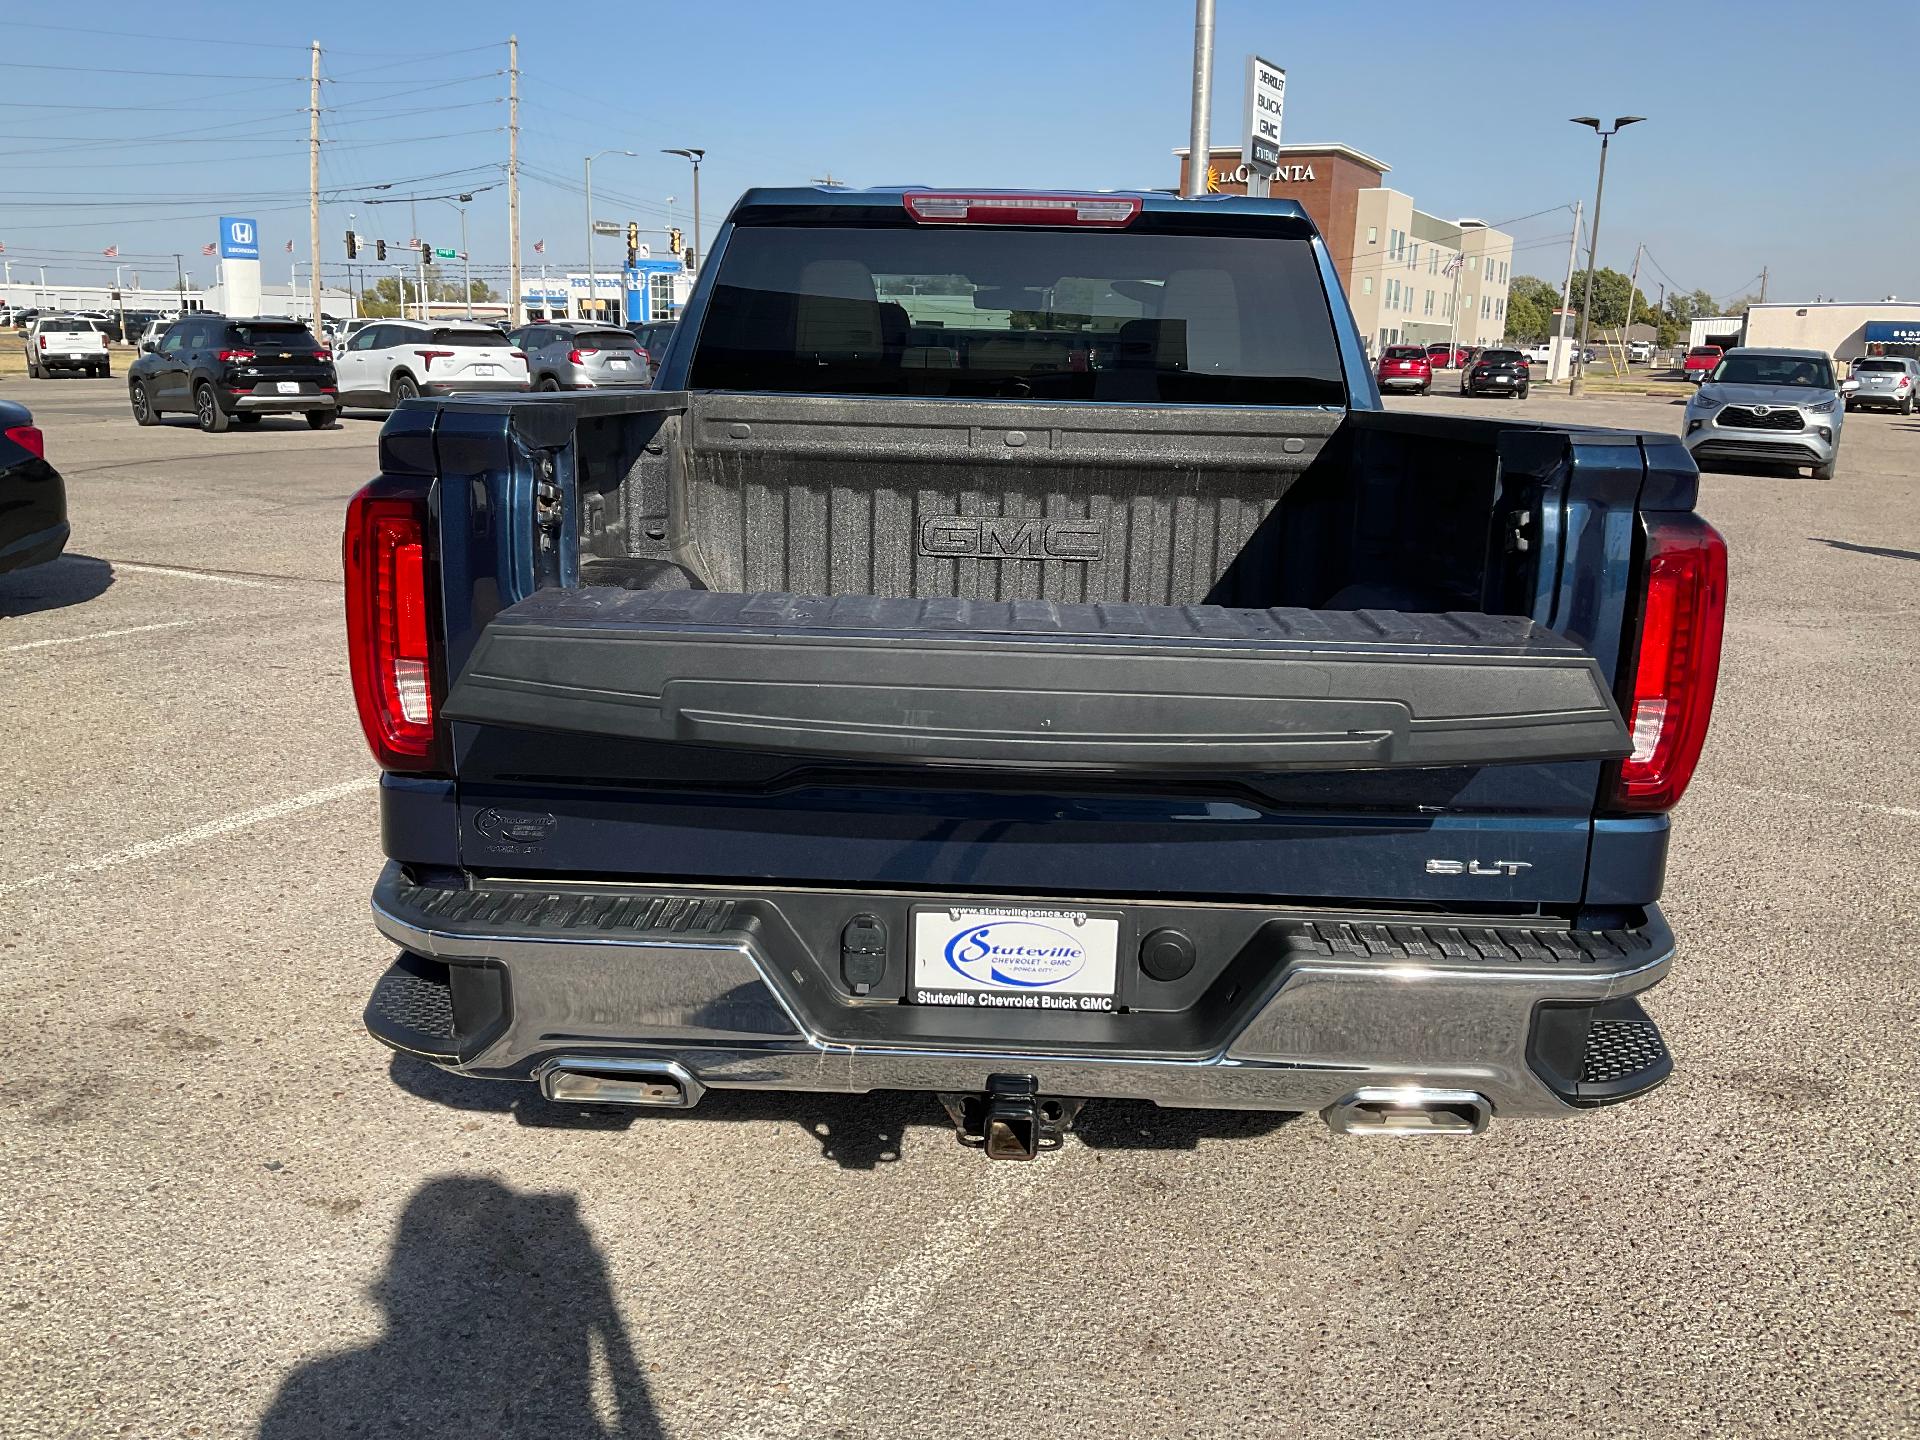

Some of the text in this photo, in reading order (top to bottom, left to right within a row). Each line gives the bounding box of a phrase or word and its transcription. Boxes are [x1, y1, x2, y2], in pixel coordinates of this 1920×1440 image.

[1259, 69, 1285, 91] CHEVROLET
[1258, 93, 1282, 116] BUICK
[1259, 119, 1279, 139] GMC
[1235, 164, 1316, 183] QNTA
[529, 288, 557, 297] Serice
[922, 518, 1101, 558] GMC
[1424, 860, 1533, 876] SLT
[950, 907, 1087, 919] www.stutevilleponca.com
[958, 929, 1082, 962] Stuteville
[991, 957, 1072, 967] CHEVROLET GMC
[917, 990, 1112, 1011] Stuteville Chevrolet Buick GMC
